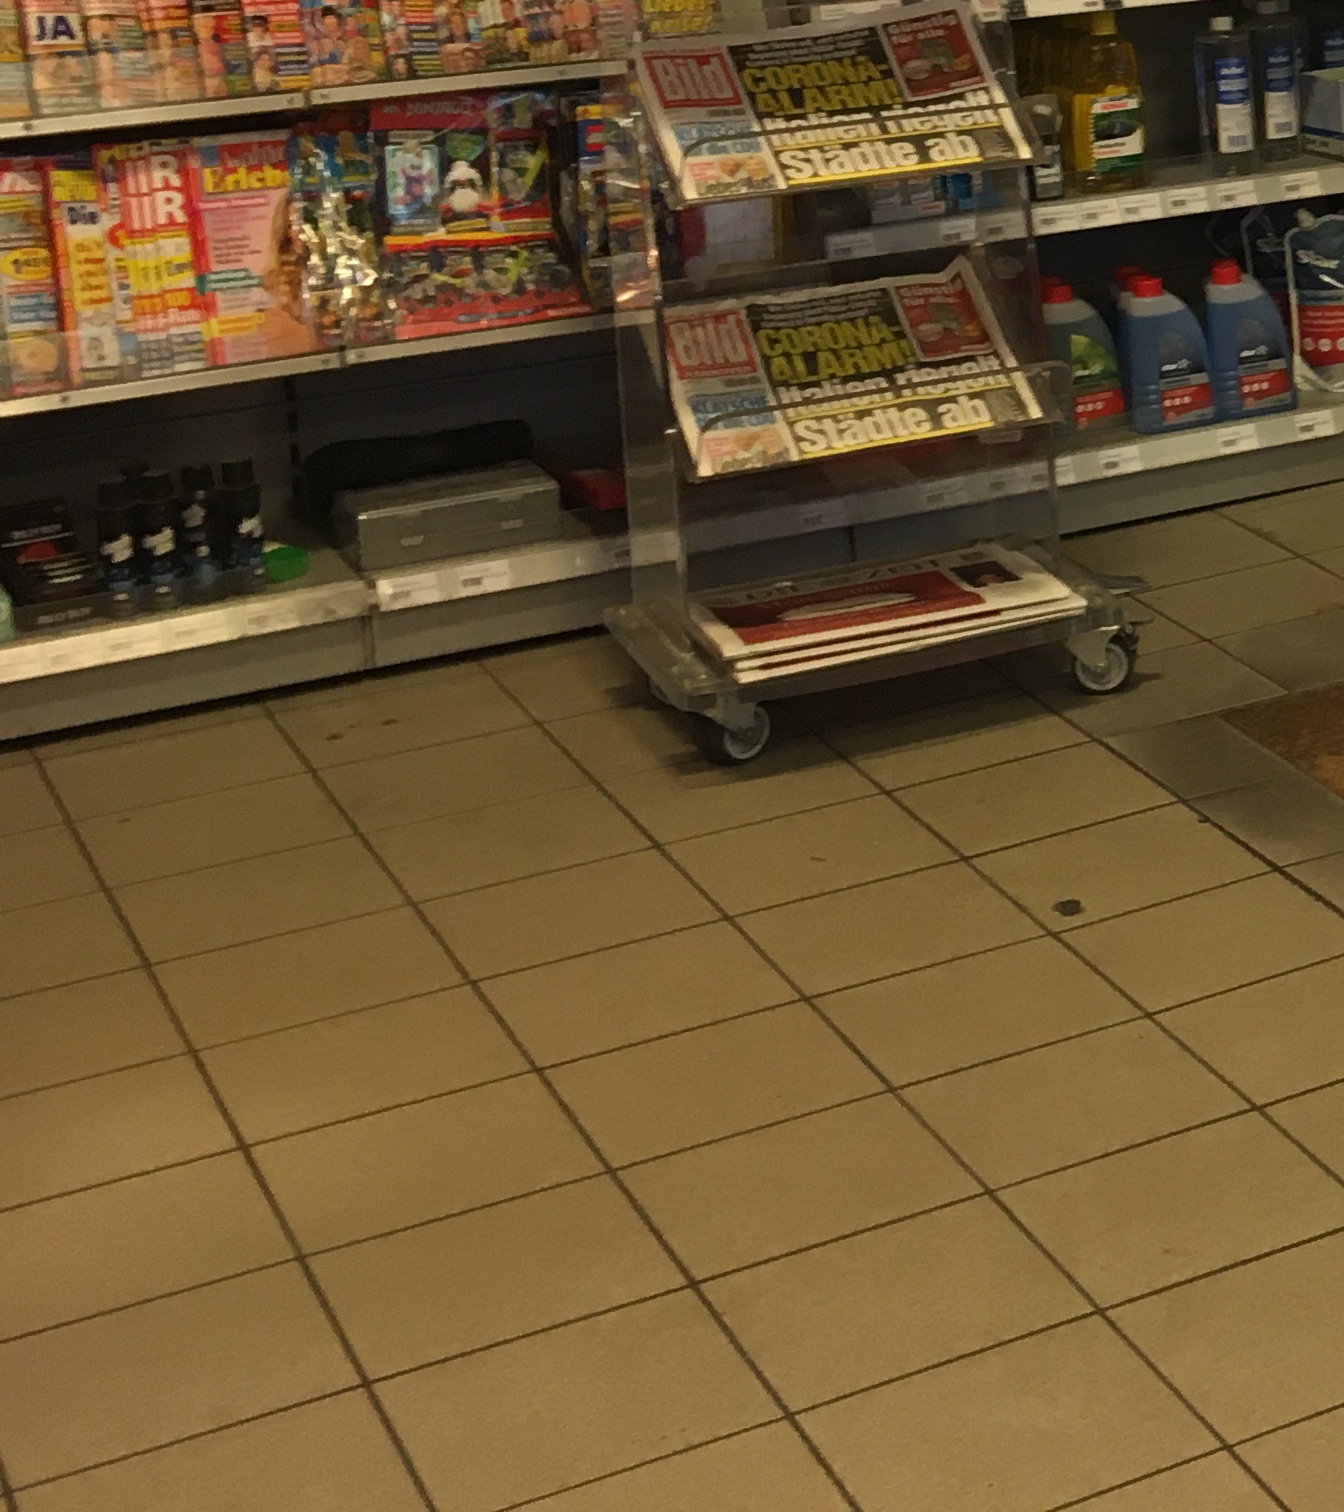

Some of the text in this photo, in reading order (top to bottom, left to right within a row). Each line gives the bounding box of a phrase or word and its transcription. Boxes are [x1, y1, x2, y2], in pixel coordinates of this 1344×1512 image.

[652, 55, 734, 101] Bild
[740, 54, 888, 93] CORONA-
[753, 78, 901, 116] ALARM!
[784, 132, 979, 180] Städte ab
[757, 315, 902, 356] CORONA-
[769, 339, 915, 383] ALARM!
[797, 395, 992, 454] Städte ab
